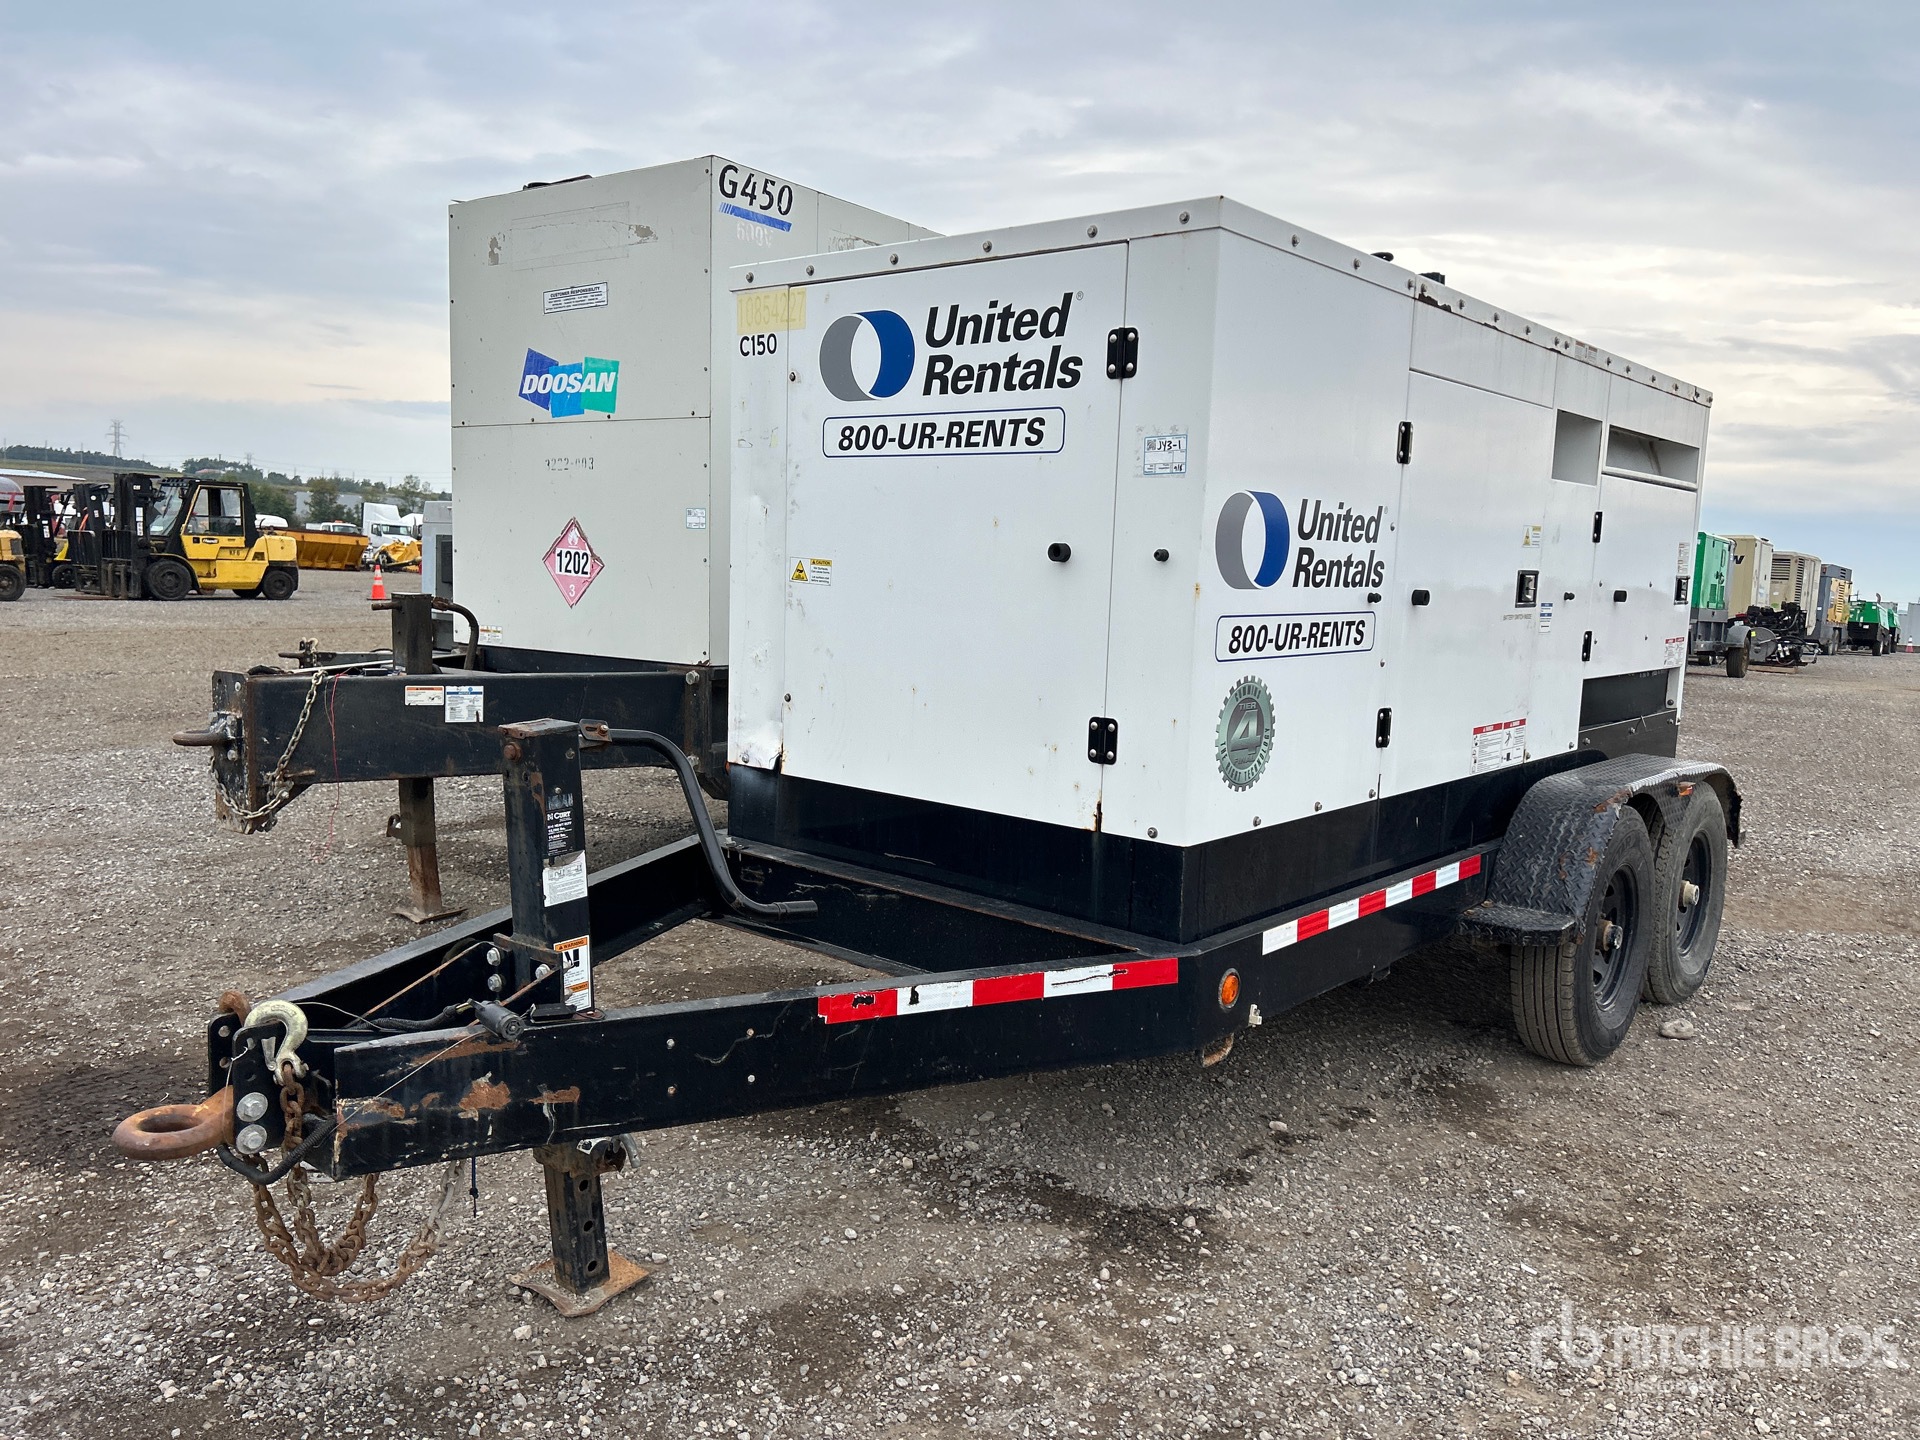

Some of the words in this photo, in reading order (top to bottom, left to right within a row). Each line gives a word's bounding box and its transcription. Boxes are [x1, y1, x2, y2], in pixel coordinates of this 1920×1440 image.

[718, 164, 793, 216] G450
[550, 290, 570, 298] CUSTOMER
[925, 291, 1073, 349] United
[740, 333, 777, 357] C150
[521, 371, 617, 395] DOOSAN
[922, 344, 1083, 397] Rentals
[837, 416, 1047, 452] 800-UR-RENTS
[1297, 498, 1384, 544] United
[556, 549, 589, 576] 1202
[1292, 546, 1385, 588] Rentals
[568, 583, 576, 597] 3
[1228, 619, 1366, 654] 800-UR-RENTS
[1238, 701, 1257, 711] TIER
[1230, 709, 1262, 754] 4
[1220, 742, 1228, 761] THE
[563, 940, 585, 950] WARNING
